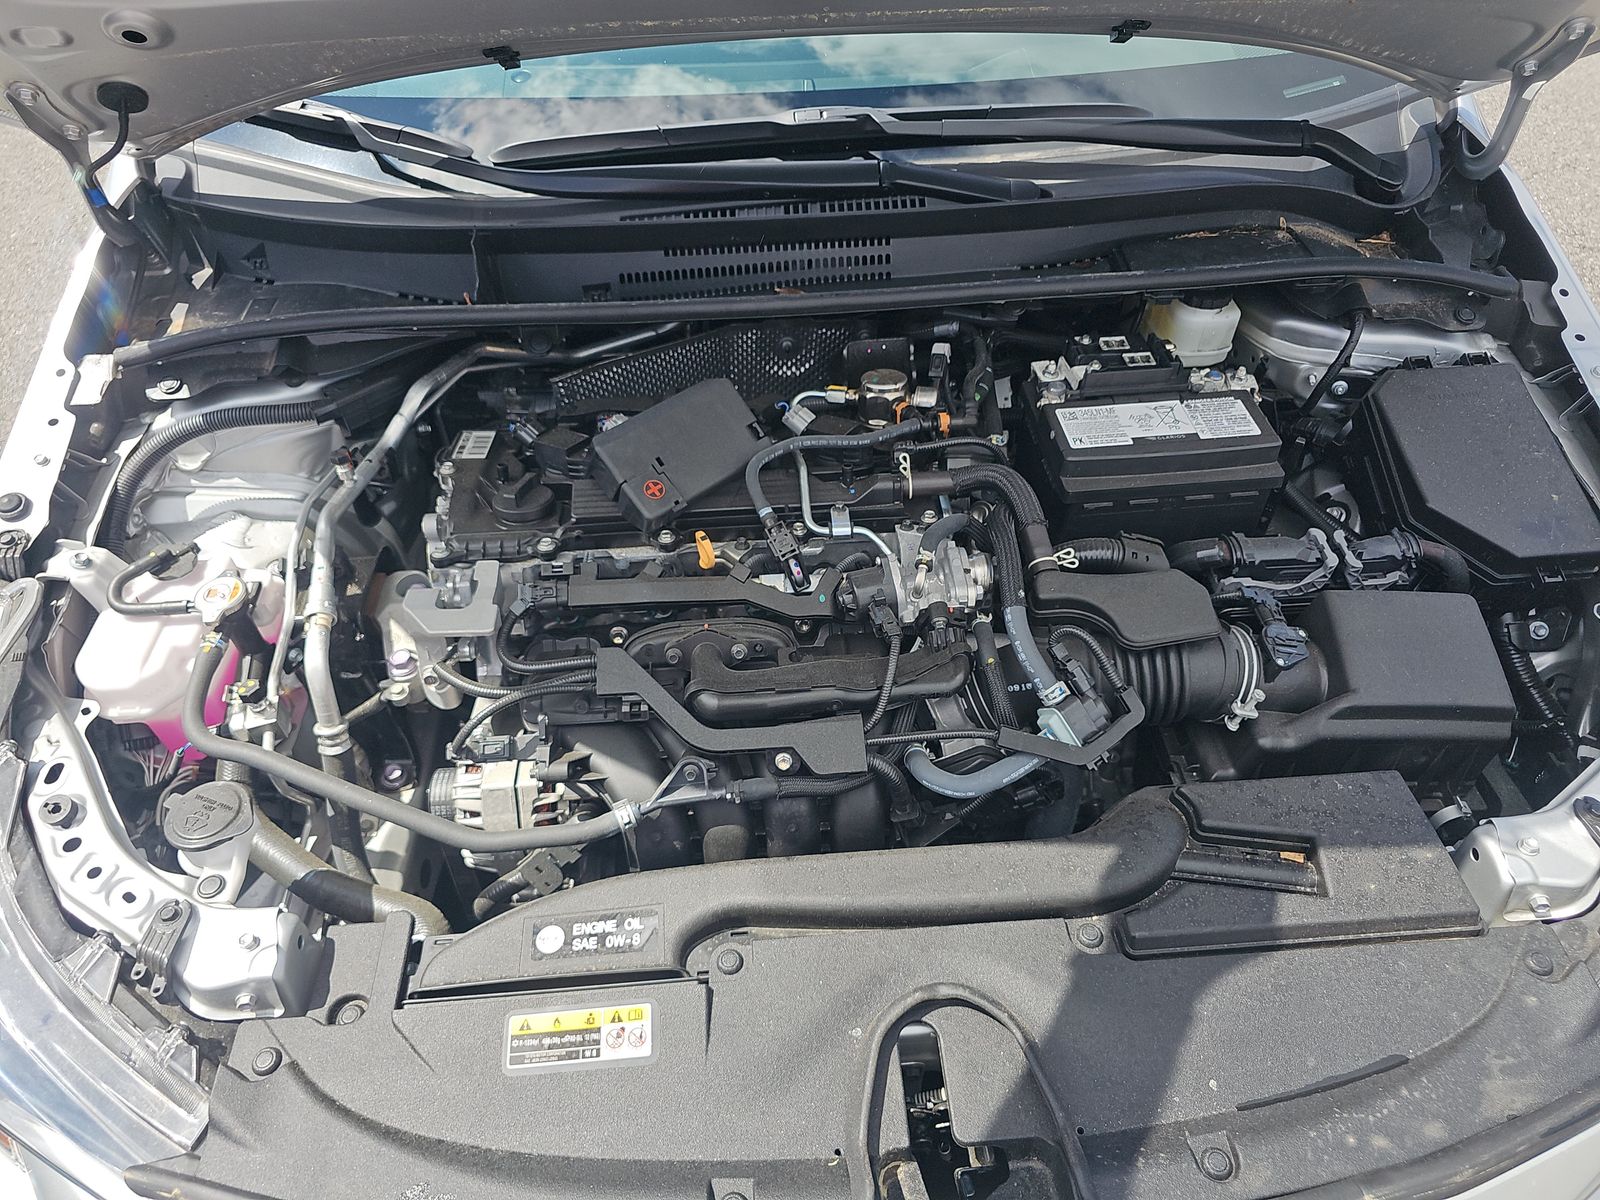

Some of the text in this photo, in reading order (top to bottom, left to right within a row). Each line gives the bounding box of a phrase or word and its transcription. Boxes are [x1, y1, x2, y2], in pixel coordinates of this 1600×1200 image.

[1072, 436, 1086, 446] PK
[572, 917, 645, 936] ENGINE OIL
[571, 933, 641, 952] SAE 0W-8
